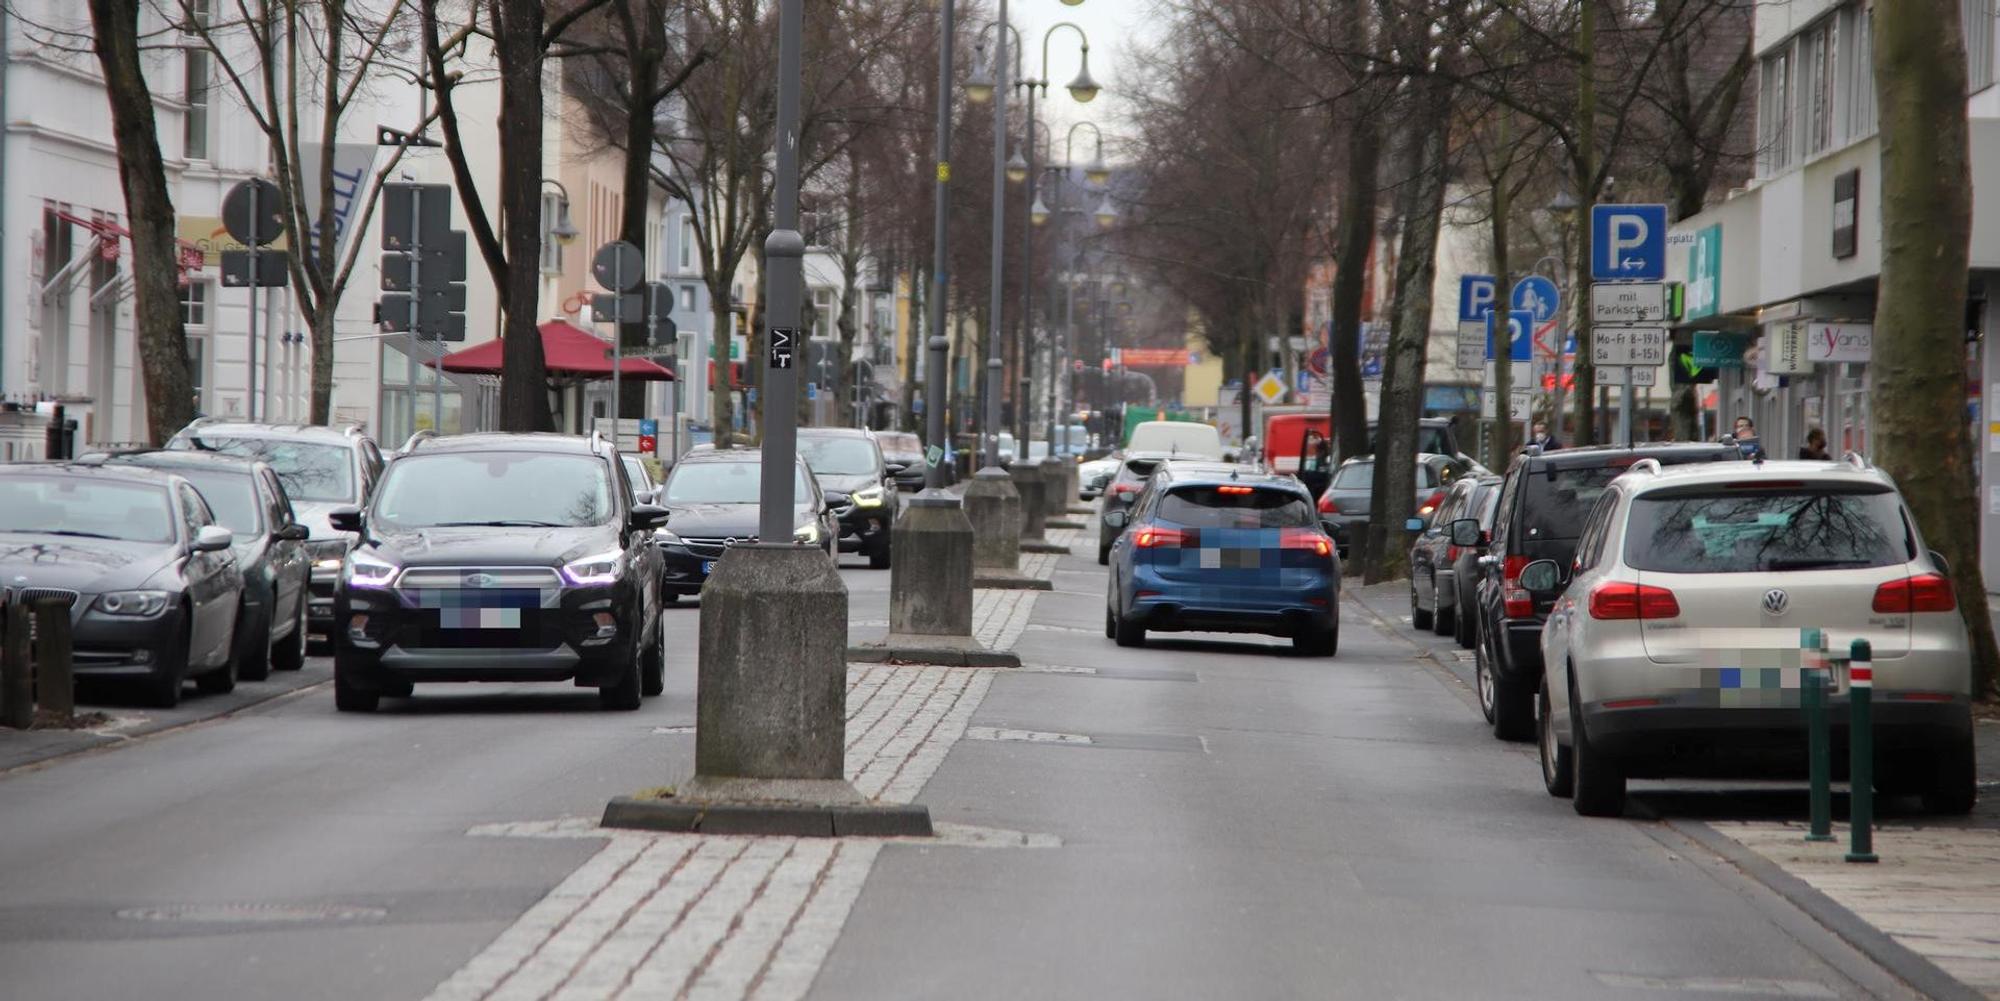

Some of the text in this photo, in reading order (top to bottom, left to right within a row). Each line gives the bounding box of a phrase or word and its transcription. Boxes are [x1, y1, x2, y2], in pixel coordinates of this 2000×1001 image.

[1610, 215, 1648, 269] P
[1619, 292, 1637, 301] mit
[1597, 304, 1660, 315] Parkschein
[1597, 333, 1625, 345] Mo-Fr
[1597, 349, 1608, 359] Sa
